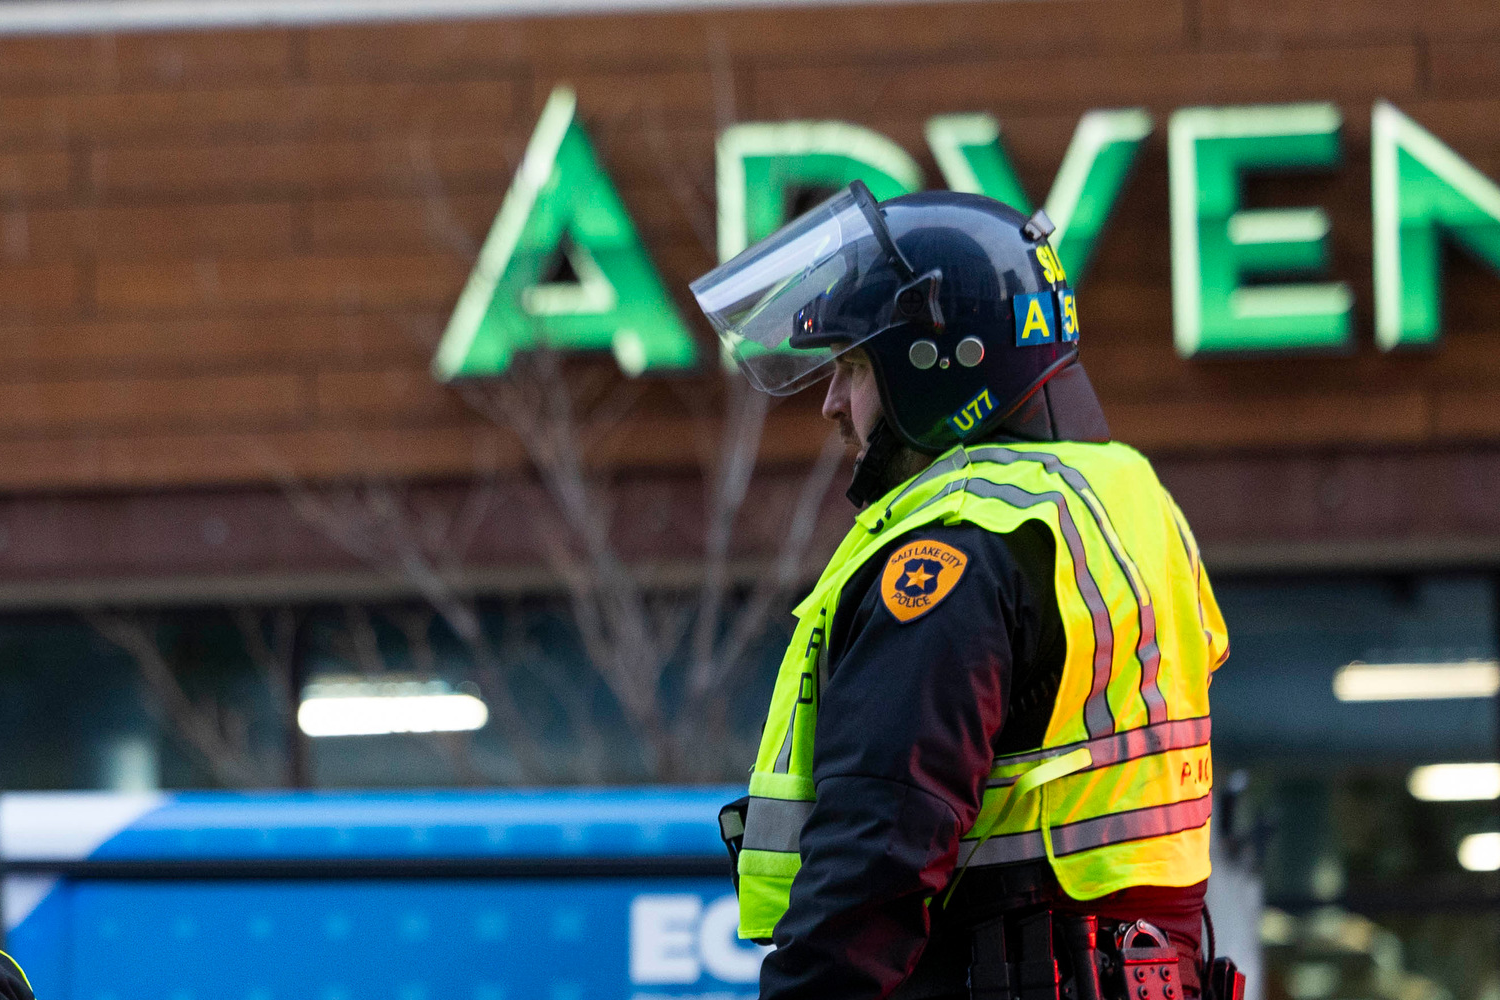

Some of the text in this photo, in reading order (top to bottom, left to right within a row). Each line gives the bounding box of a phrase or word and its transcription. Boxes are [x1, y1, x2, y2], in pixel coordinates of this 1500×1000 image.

[1021, 298, 1050, 339] A
[953, 388, 993, 431] U77
[891, 546, 964, 569] SALT LAKE CITY
[891, 592, 931, 608] POLICE
